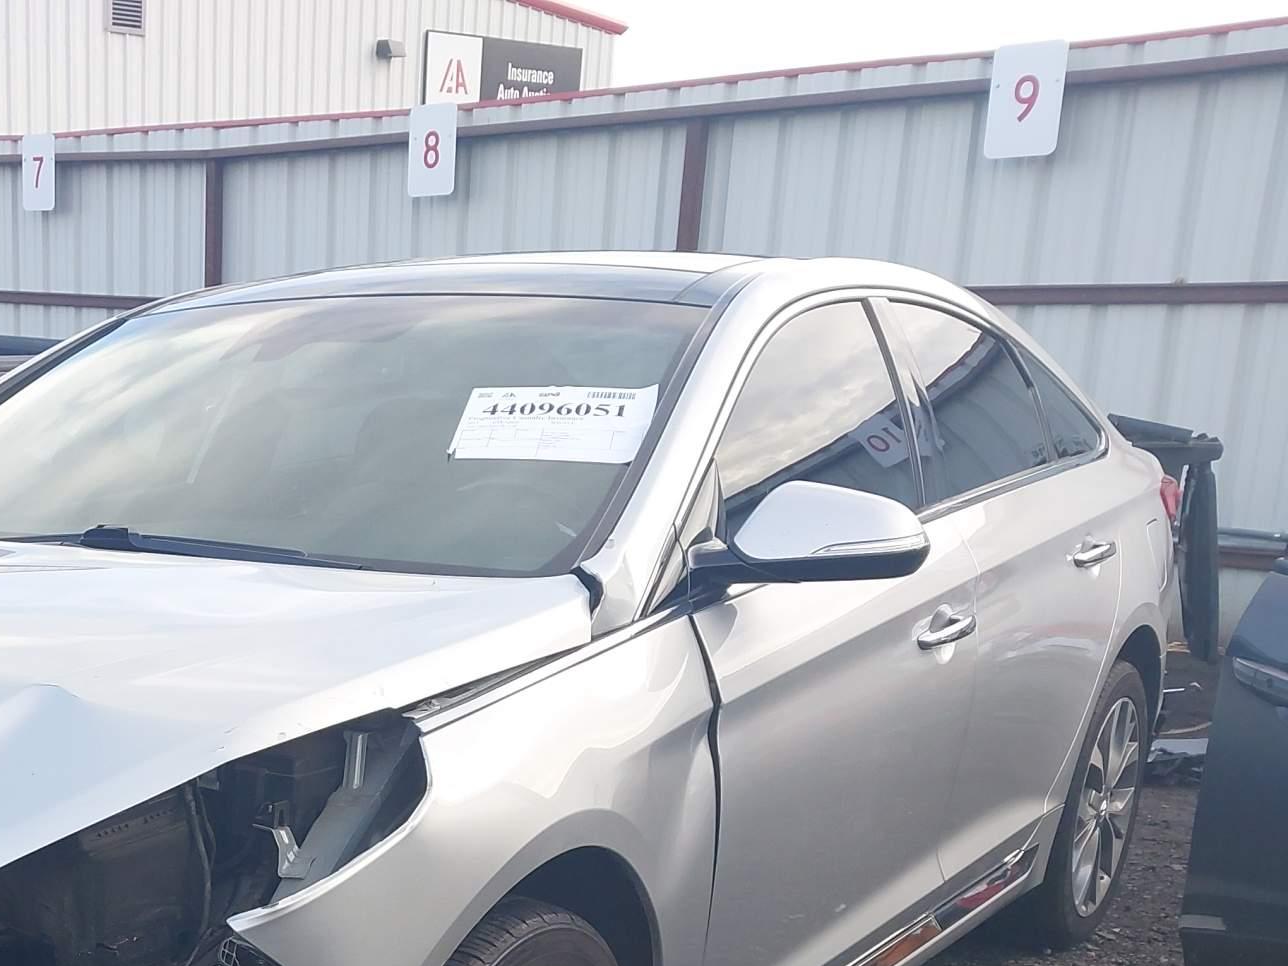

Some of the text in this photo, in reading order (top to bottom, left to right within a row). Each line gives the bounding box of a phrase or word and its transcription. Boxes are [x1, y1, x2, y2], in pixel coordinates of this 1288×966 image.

[507, 62, 554, 84] Insurance
[1015, 74, 1040, 123] 9
[423, 130, 440, 169] 8
[32, 156, 44, 189] 7
[482, 403, 627, 418] 44096051
